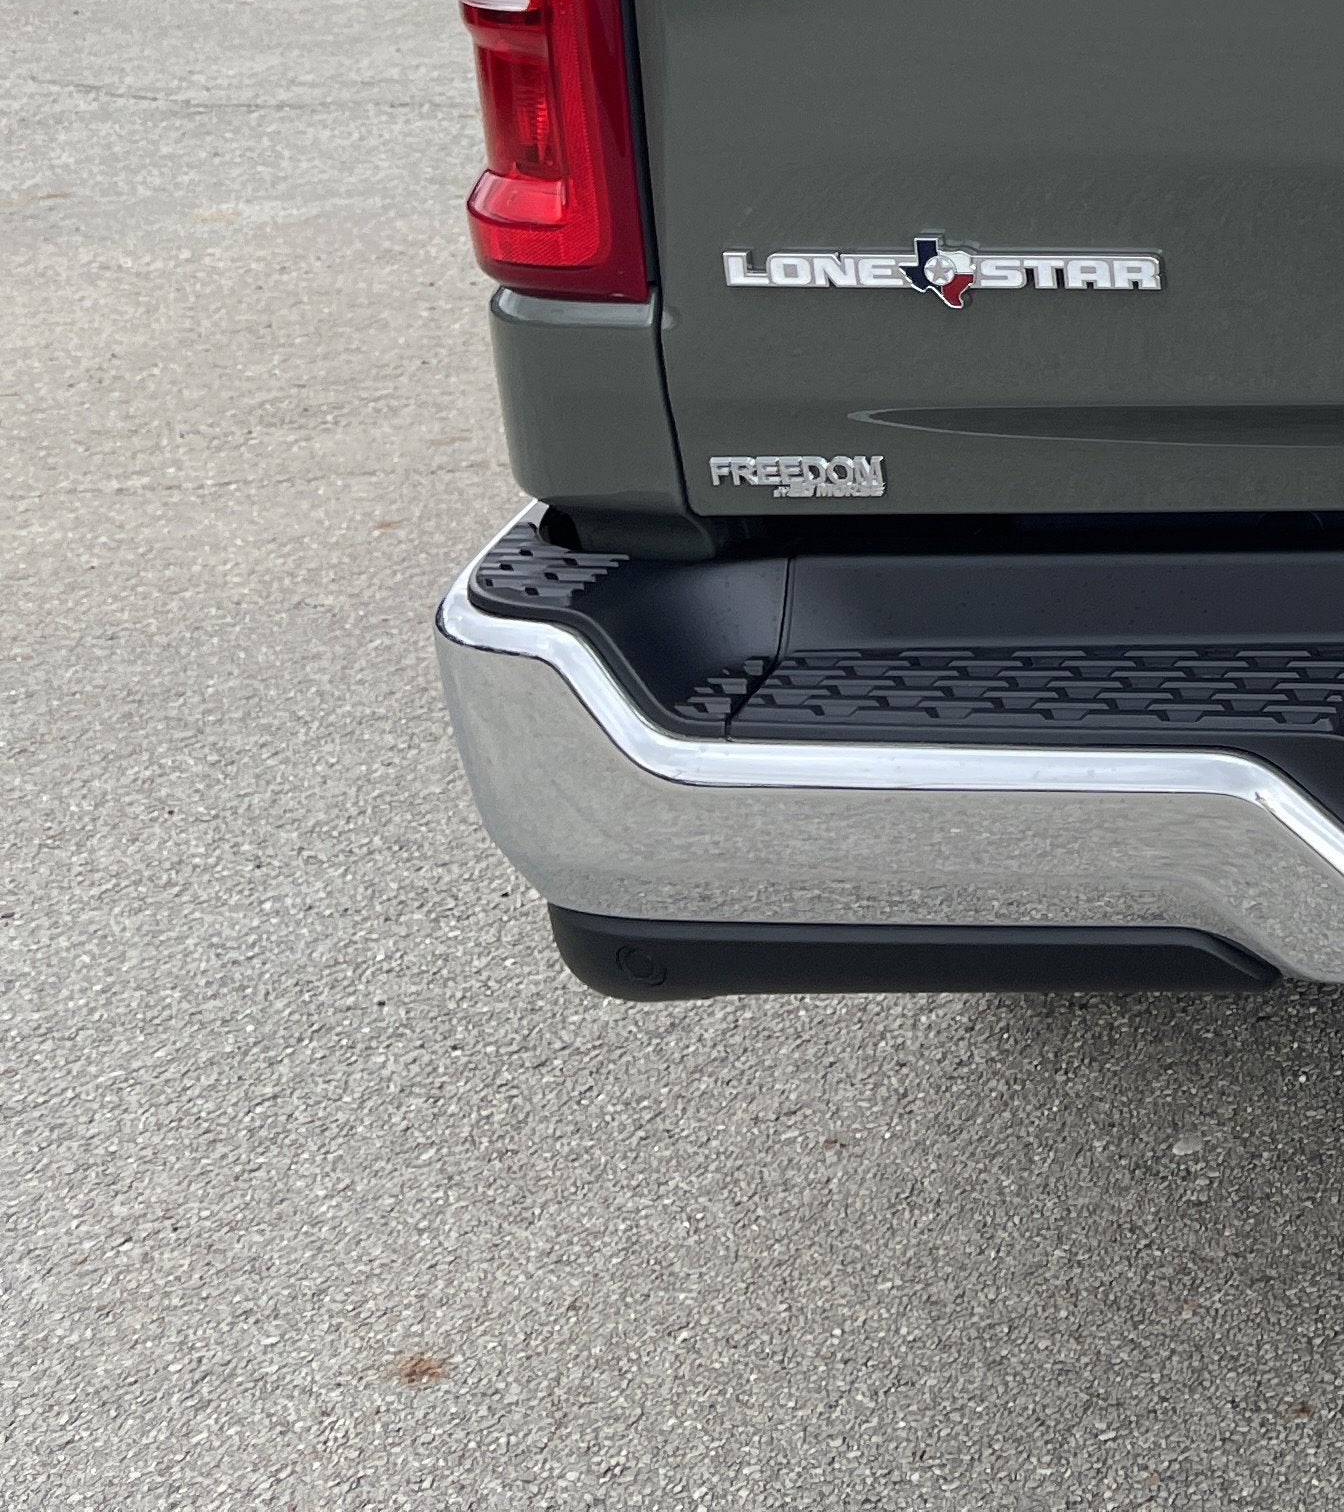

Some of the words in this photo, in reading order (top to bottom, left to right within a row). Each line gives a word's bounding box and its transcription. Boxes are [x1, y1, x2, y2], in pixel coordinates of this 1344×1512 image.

[723, 250, 901, 289] LONE
[976, 253, 1163, 291] STAR
[709, 455, 886, 487] FREEDOM
